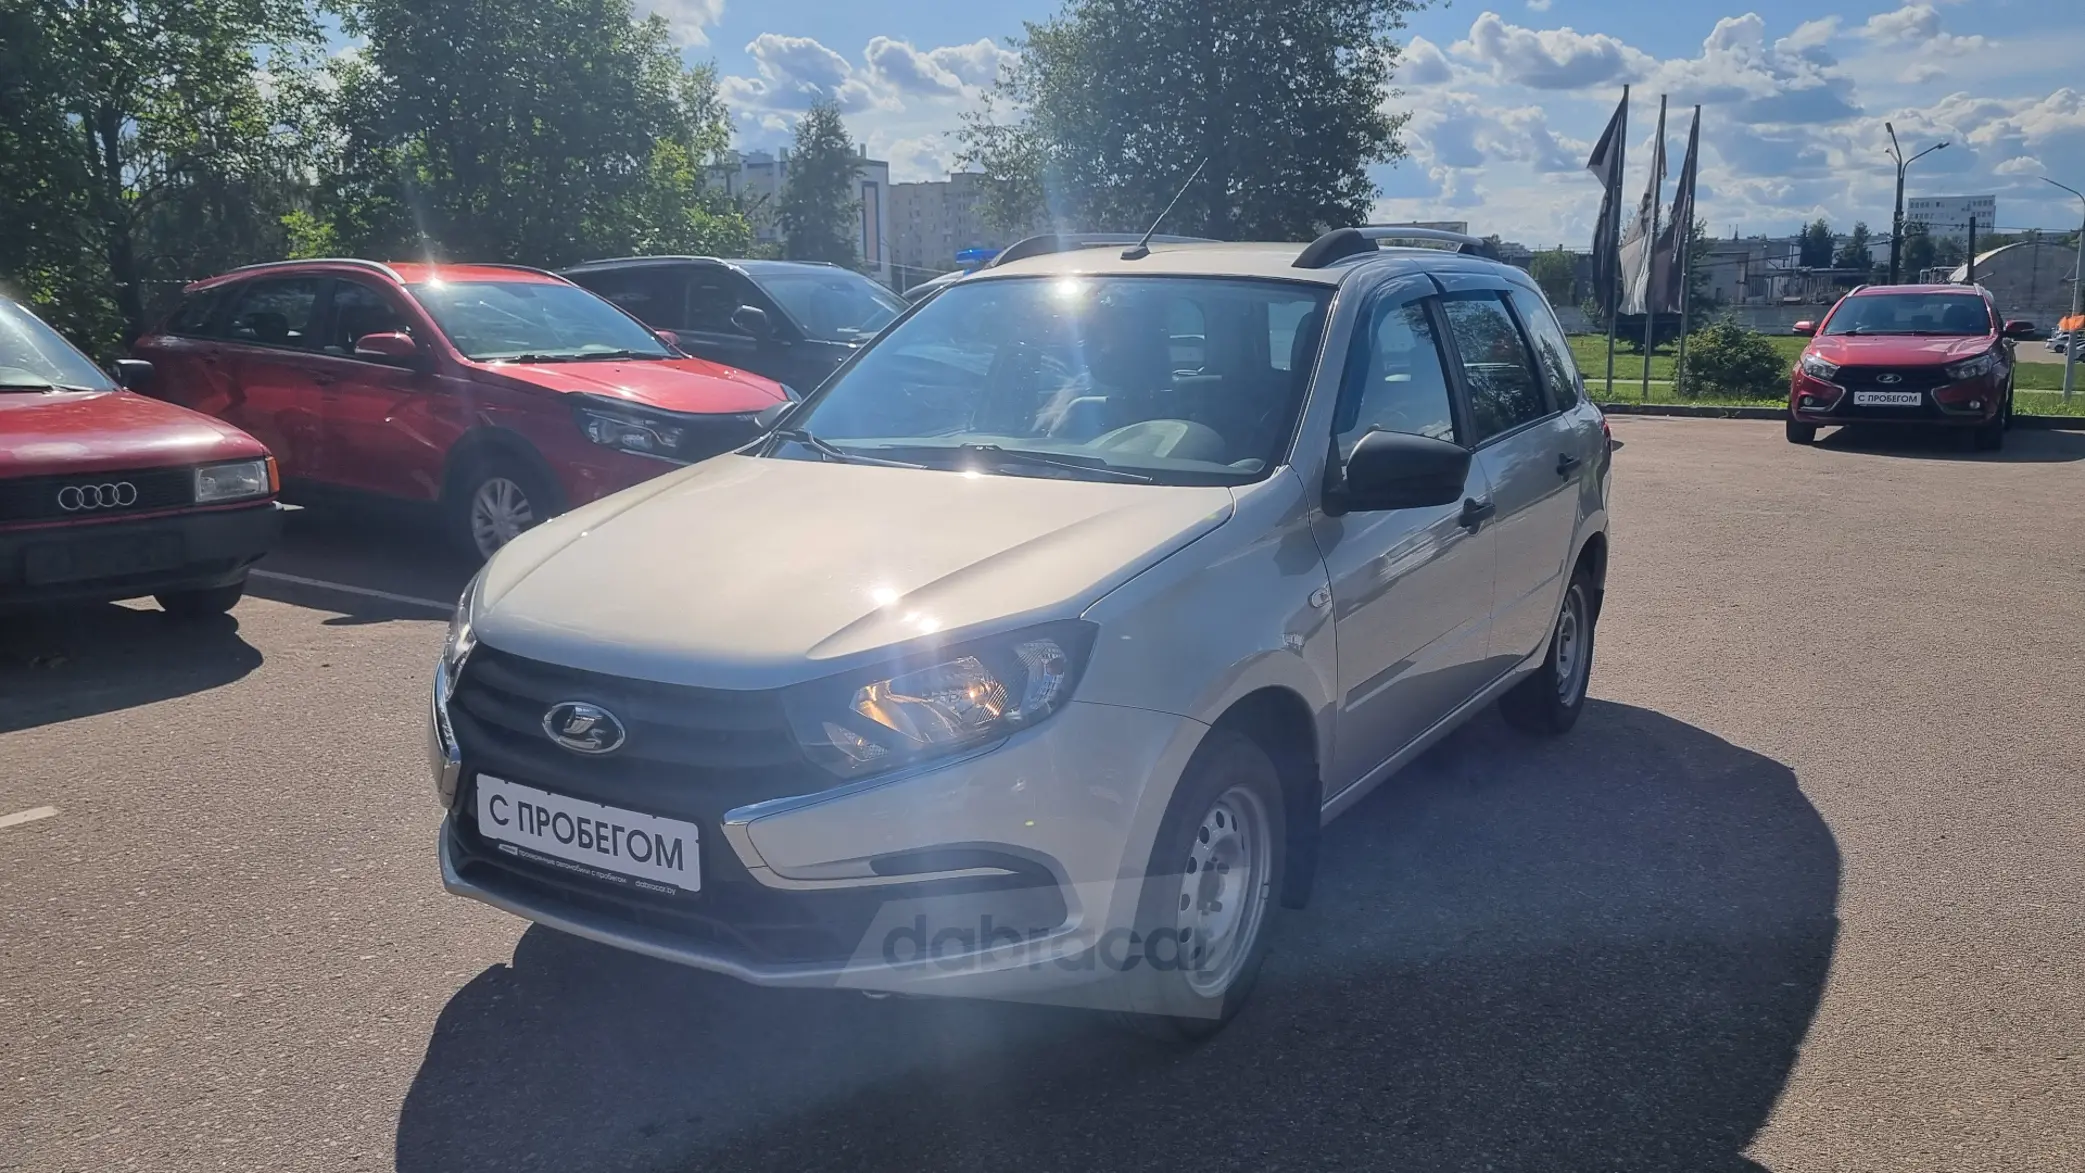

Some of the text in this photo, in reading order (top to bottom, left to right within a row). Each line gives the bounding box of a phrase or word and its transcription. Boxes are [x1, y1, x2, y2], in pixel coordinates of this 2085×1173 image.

[489, 794, 684, 871] С ПРОБЕГОМ
[597, 871, 627, 884] пробегом
[635, 880, 676, 896] dabracar.by
